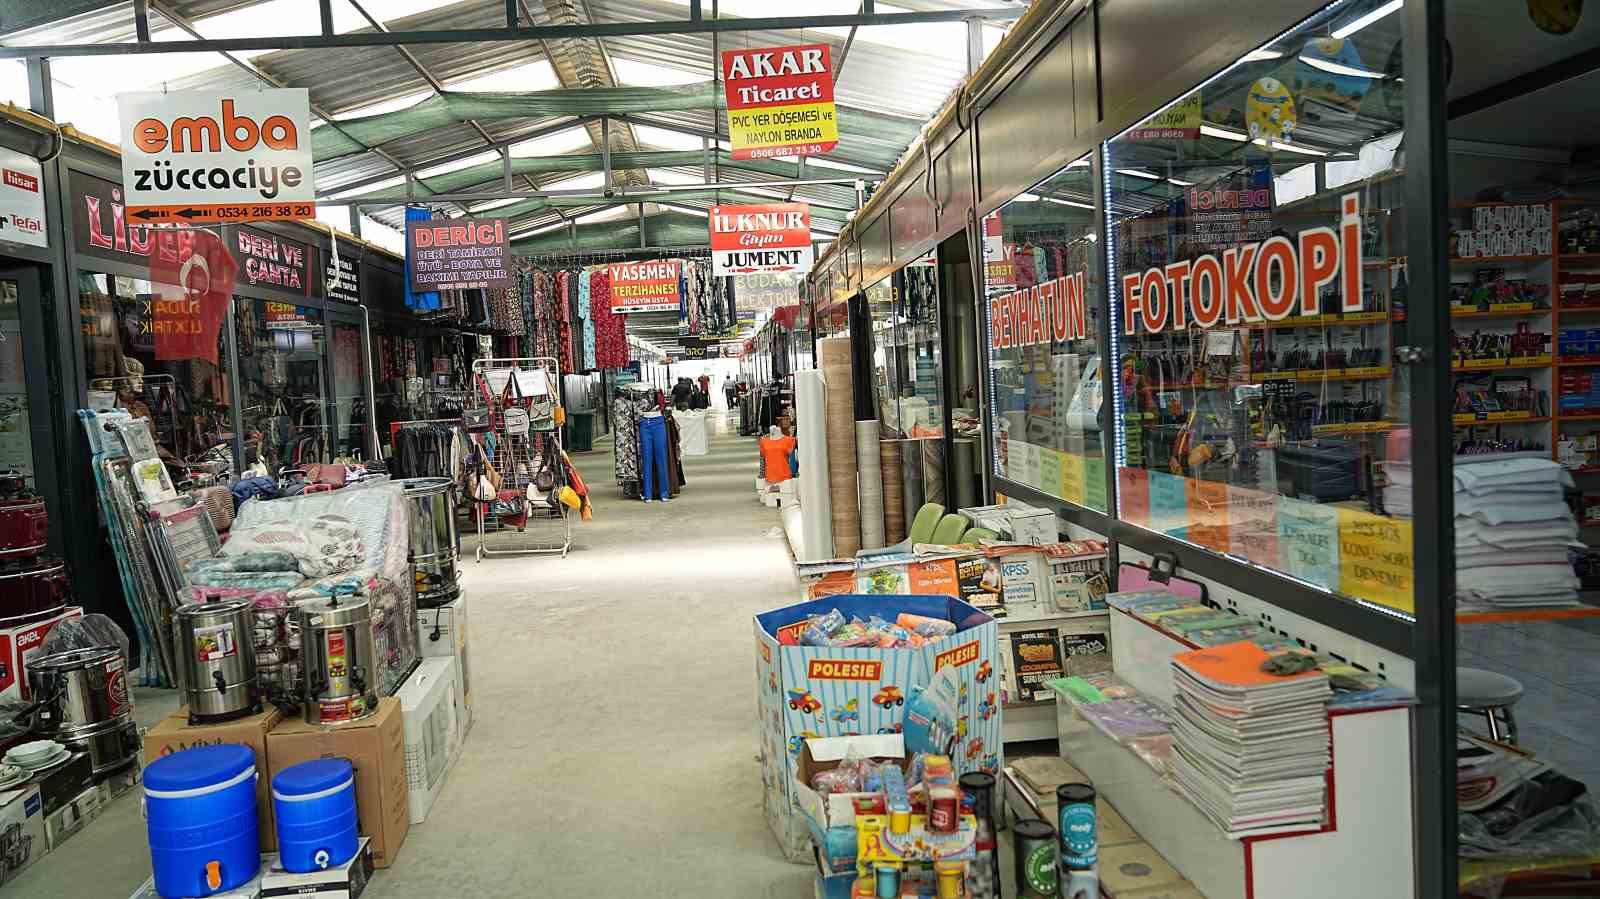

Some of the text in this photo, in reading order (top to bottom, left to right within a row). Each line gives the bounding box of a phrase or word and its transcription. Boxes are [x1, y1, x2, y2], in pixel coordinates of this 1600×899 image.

[728, 50, 826, 80] AKAR
[738, 81, 821, 104] Ticaret
[133, 99, 298, 154] emba
[732, 116, 750, 128] PVC
[752, 114, 770, 126] YER
[773, 107, 820, 127] DÖŞEMESİ
[746, 128, 822, 144] NAYLON BRANDA
[751, 149, 774, 158] 0506
[7, 171, 35, 189] hisar
[134, 159, 302, 198] züccaciye
[216, 206, 311, 218] 0534 216 38 20
[714, 208, 807, 232] İLKNUR
[10, 214, 42, 232] Tefal
[416, 220, 504, 247] DERİCİ
[238, 231, 304, 268] DERİ VE
[417, 248, 445, 260] DERİ
[451, 260, 484, 270] BOYA
[484, 259, 502, 268] VE
[722, 250, 801, 268] JUMENT
[1123, 192, 1363, 335] FOTOKOPİ
[246, 258, 301, 288] ÇANTA
[612, 264, 675, 281] YASEMEN
[613, 280, 678, 296] TERZİHANESİ
[991, 272, 1086, 350] BEYHATUN
[1002, 564, 1029, 576] KPSS
[812, 664, 875, 677] POLESIE
